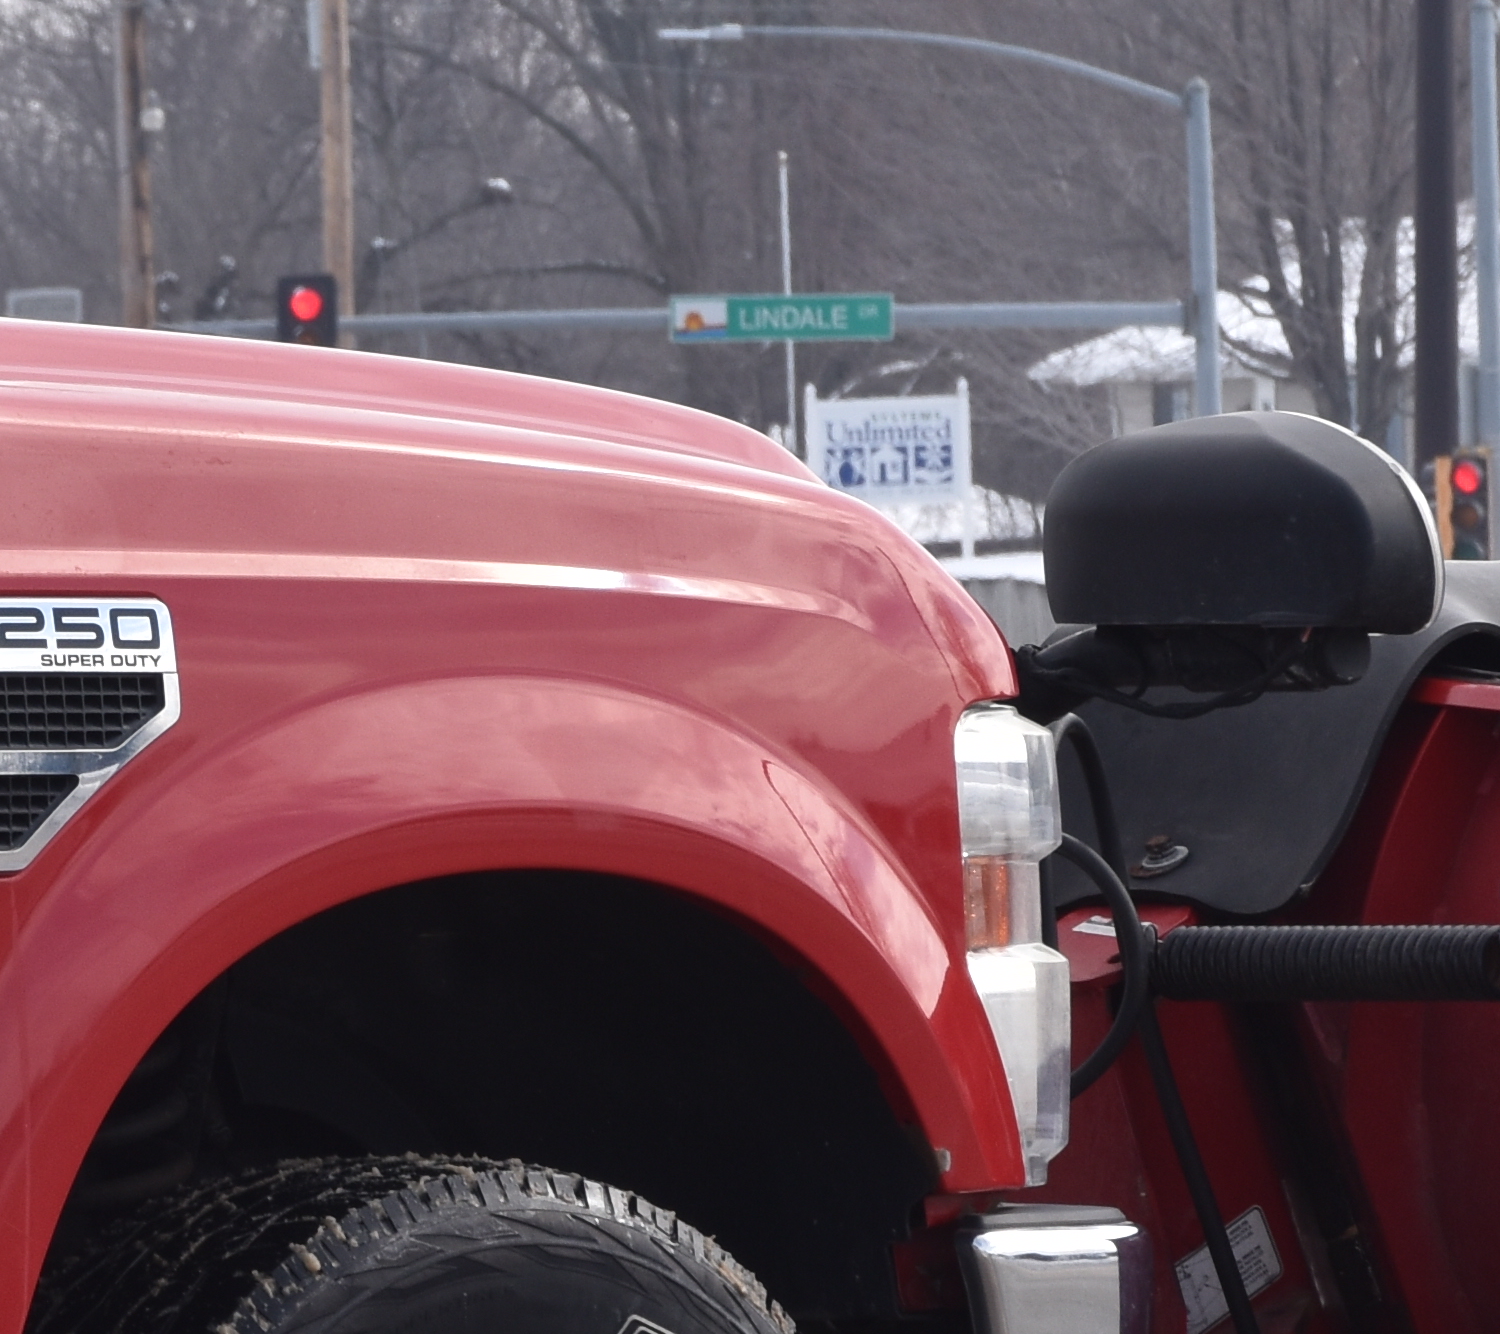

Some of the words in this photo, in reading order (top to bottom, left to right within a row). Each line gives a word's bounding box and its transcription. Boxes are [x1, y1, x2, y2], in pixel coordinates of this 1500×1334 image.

[739, 304, 849, 331] LINDALE
[826, 418, 951, 442] Unlimited
[40, 654, 105, 667] SUPER
[110, 654, 162, 667] DUTY
